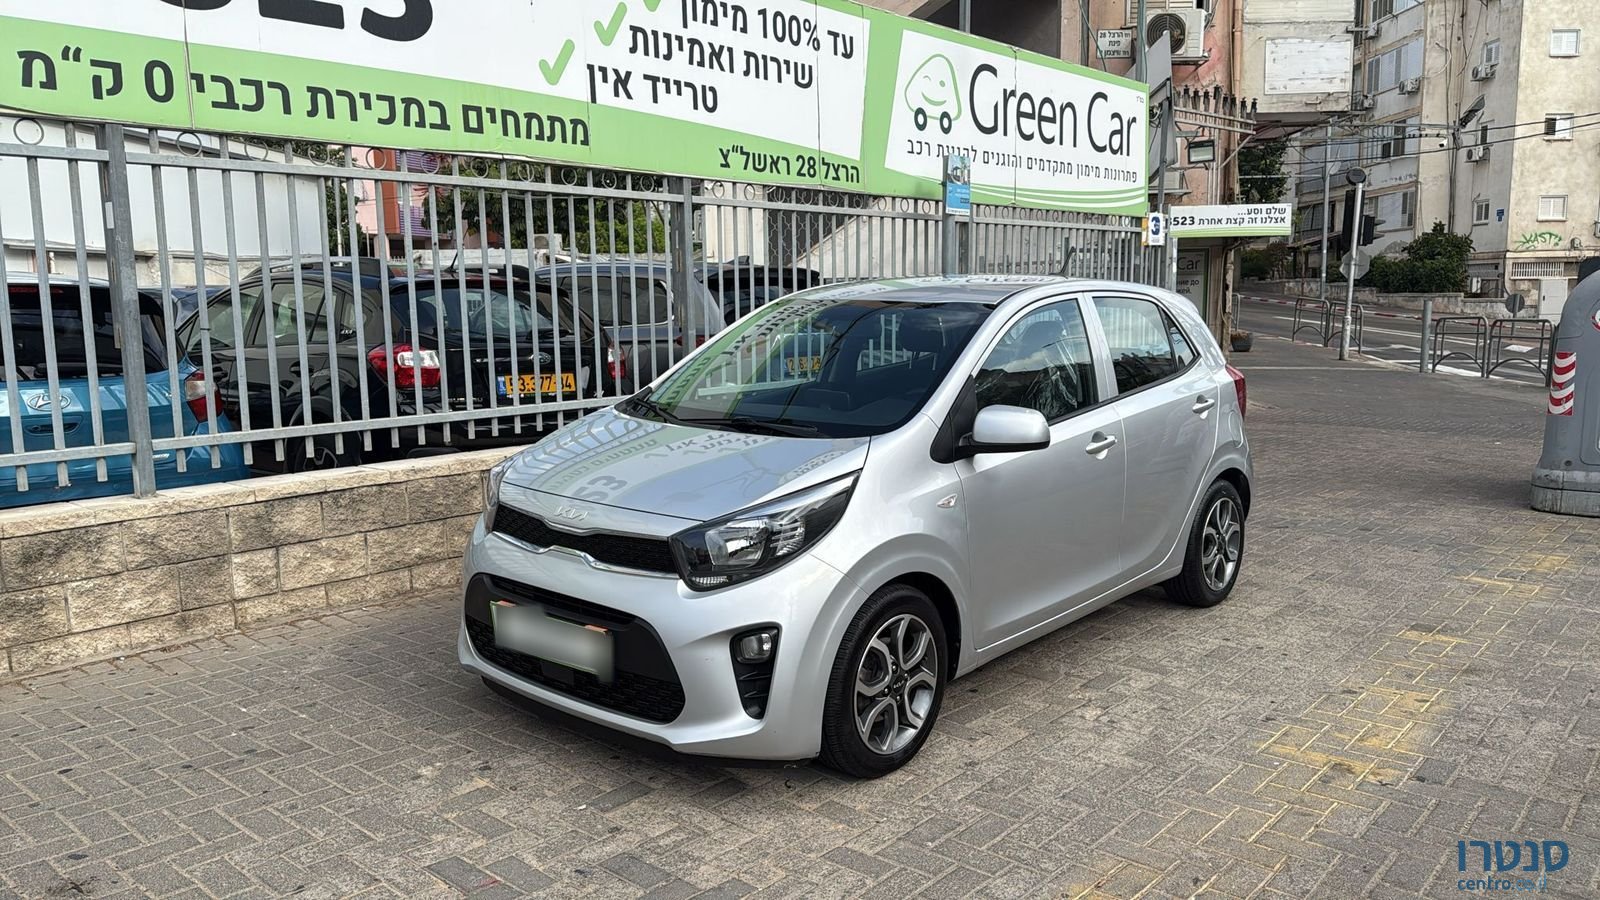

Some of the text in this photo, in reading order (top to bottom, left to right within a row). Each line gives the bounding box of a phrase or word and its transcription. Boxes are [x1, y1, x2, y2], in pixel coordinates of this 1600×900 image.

[681, 0, 854, 60] עד 100% מימון
[628, 25, 814, 89] שירות ואמינות
[17, 45, 589, 146] מתמחים במכירת רכבי 0 ק"מ
[586, 63, 718, 113] טרייד אין
[969, 63, 1137, 157] Green Car
[907, 139, 931, 156] רכב
[719, 144, 860, 183] הרצל 28 ראשל"צ
[982, 151, 1022, 168] והוגנים
[1027, 157, 1073, 177] מתקדמים
[1077, 163, 1100, 180] מימון
[1104, 167, 1137, 183] פתרונות
[1260, 215, 1286, 224] אצלנו
[1265, 206, 1287, 215] שלם
[1225, 217, 1245, 226] קצת
